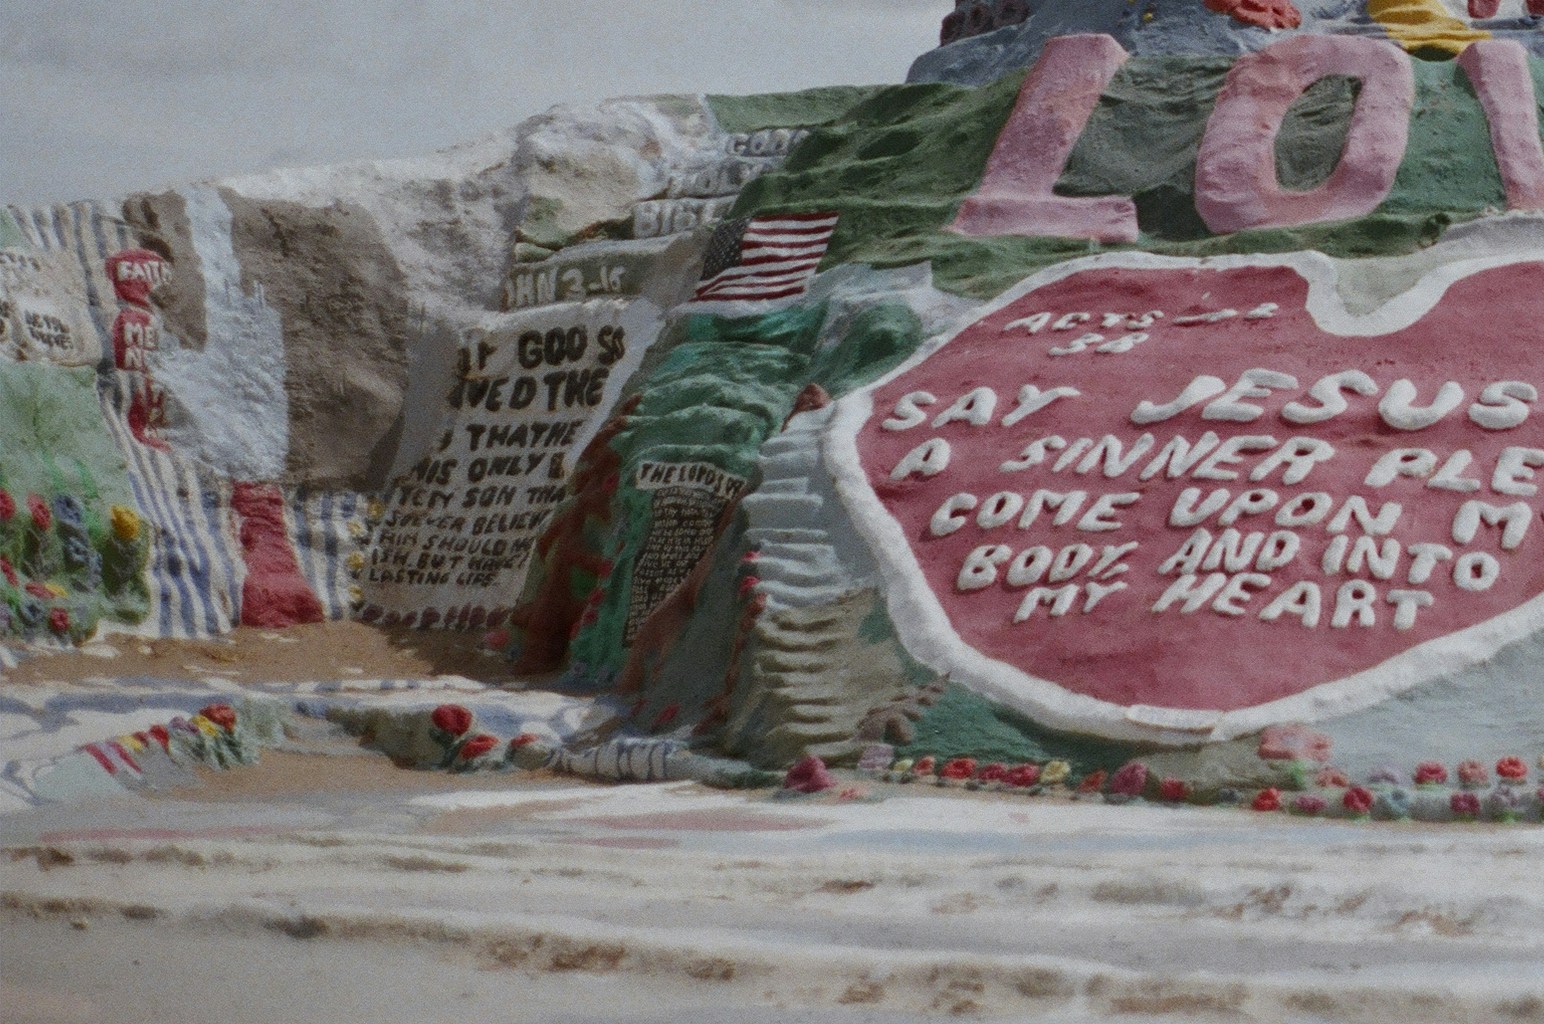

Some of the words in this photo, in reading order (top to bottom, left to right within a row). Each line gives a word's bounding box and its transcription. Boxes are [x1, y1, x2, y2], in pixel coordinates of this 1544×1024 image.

[633, 199, 733, 238] BIBL
[597, 325, 626, 365] SO
[543, 368, 610, 411] THE
[883, 384, 1082, 430] SAY
[1131, 367, 1542, 429] JESUS
[467, 453, 547, 483] ONLY
[891, 437, 954, 478] A
[1000, 431, 1338, 484] SINNER
[462, 485, 518, 509] SON
[930, 488, 1141, 535] COME
[1170, 487, 1403, 535] UPON
[1156, 528, 1302, 576] AND
[1322, 534, 1502, 592] INTO
[1013, 581, 1129, 623] MY
[1151, 573, 1436, 632] HEART
